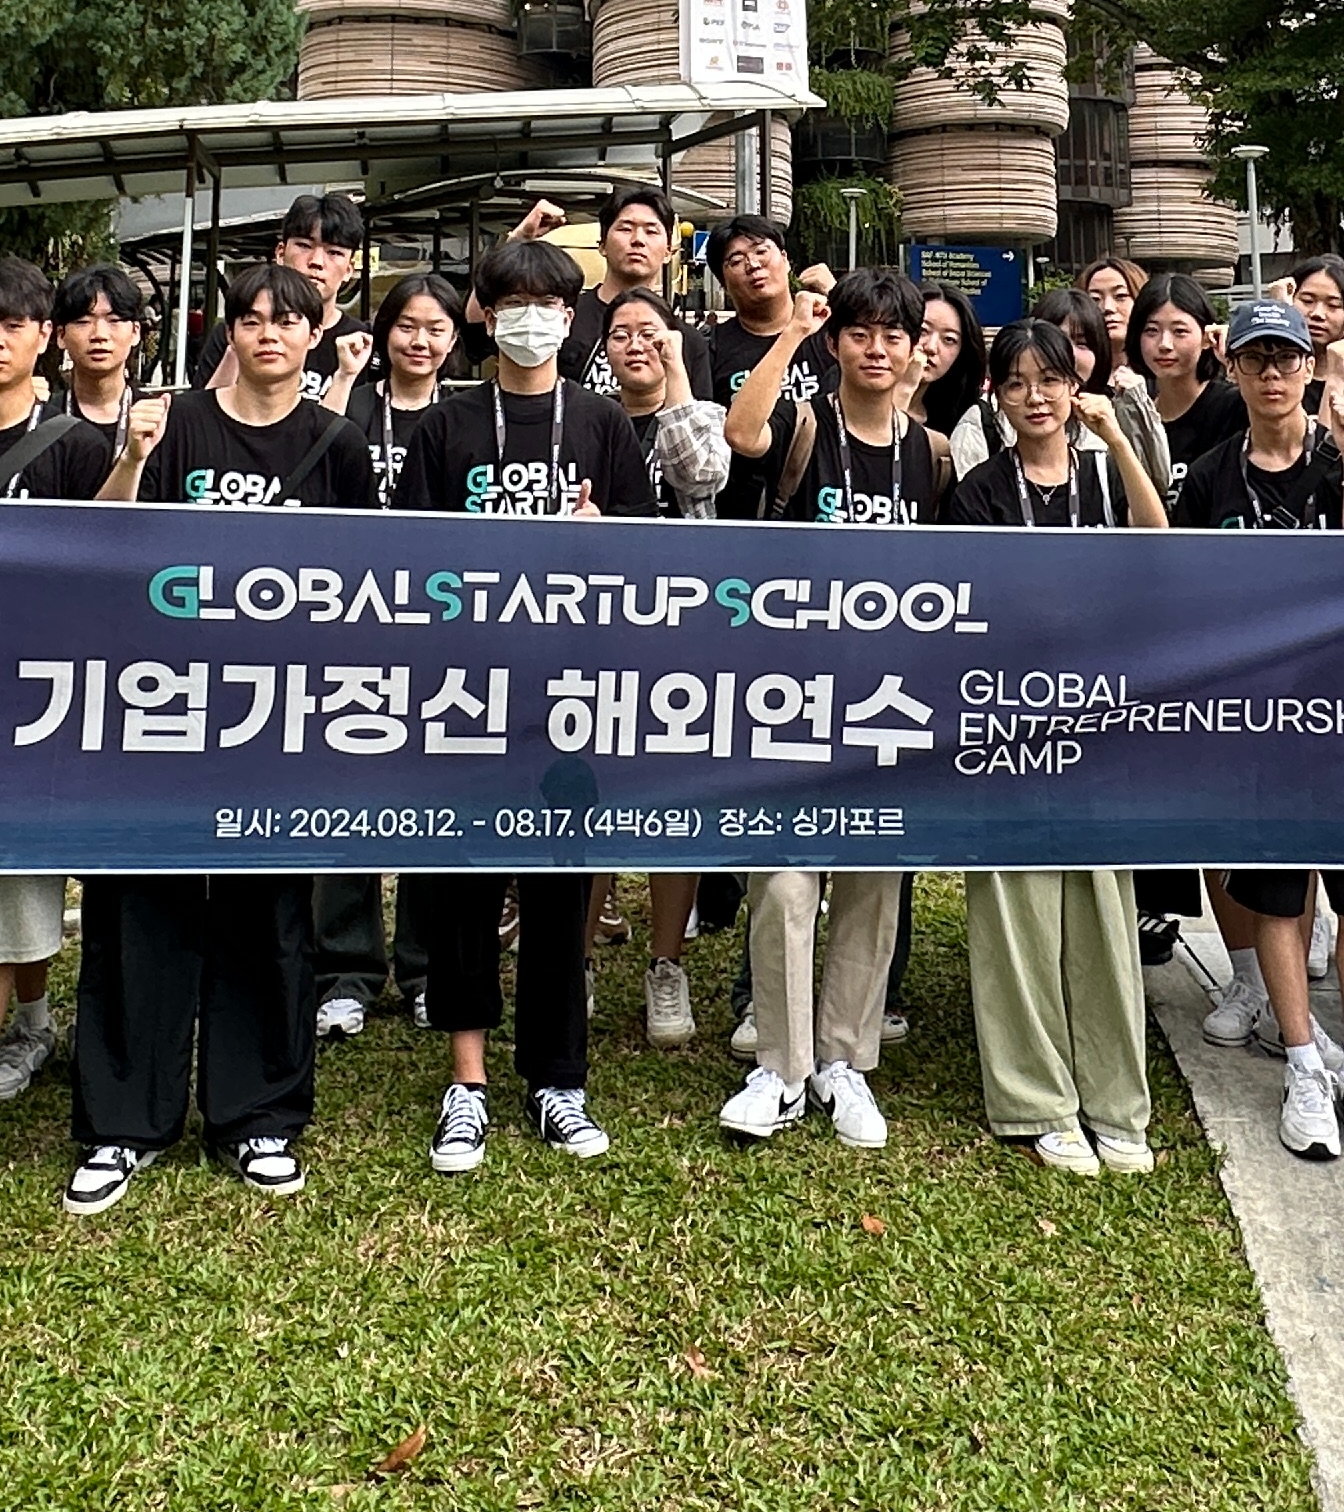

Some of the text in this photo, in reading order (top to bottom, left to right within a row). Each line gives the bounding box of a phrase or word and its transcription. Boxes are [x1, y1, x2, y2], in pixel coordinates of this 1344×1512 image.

[149, 565, 988, 633] GLOBAL STARTUP SCHOOL
[959, 669, 1141, 709] GLOBAL
[13, 659, 510, 755] 기업가정신
[547, 669, 934, 767] 해외연수
[954, 740, 1082, 775] CAMP
[215, 808, 281, 838] 일시:
[289, 808, 463, 837] 2024.08.12.
[584, 807, 702, 838] (4박6일)
[718, 807, 782, 837] 장소:
[792, 807, 905, 837] 싱가포르
